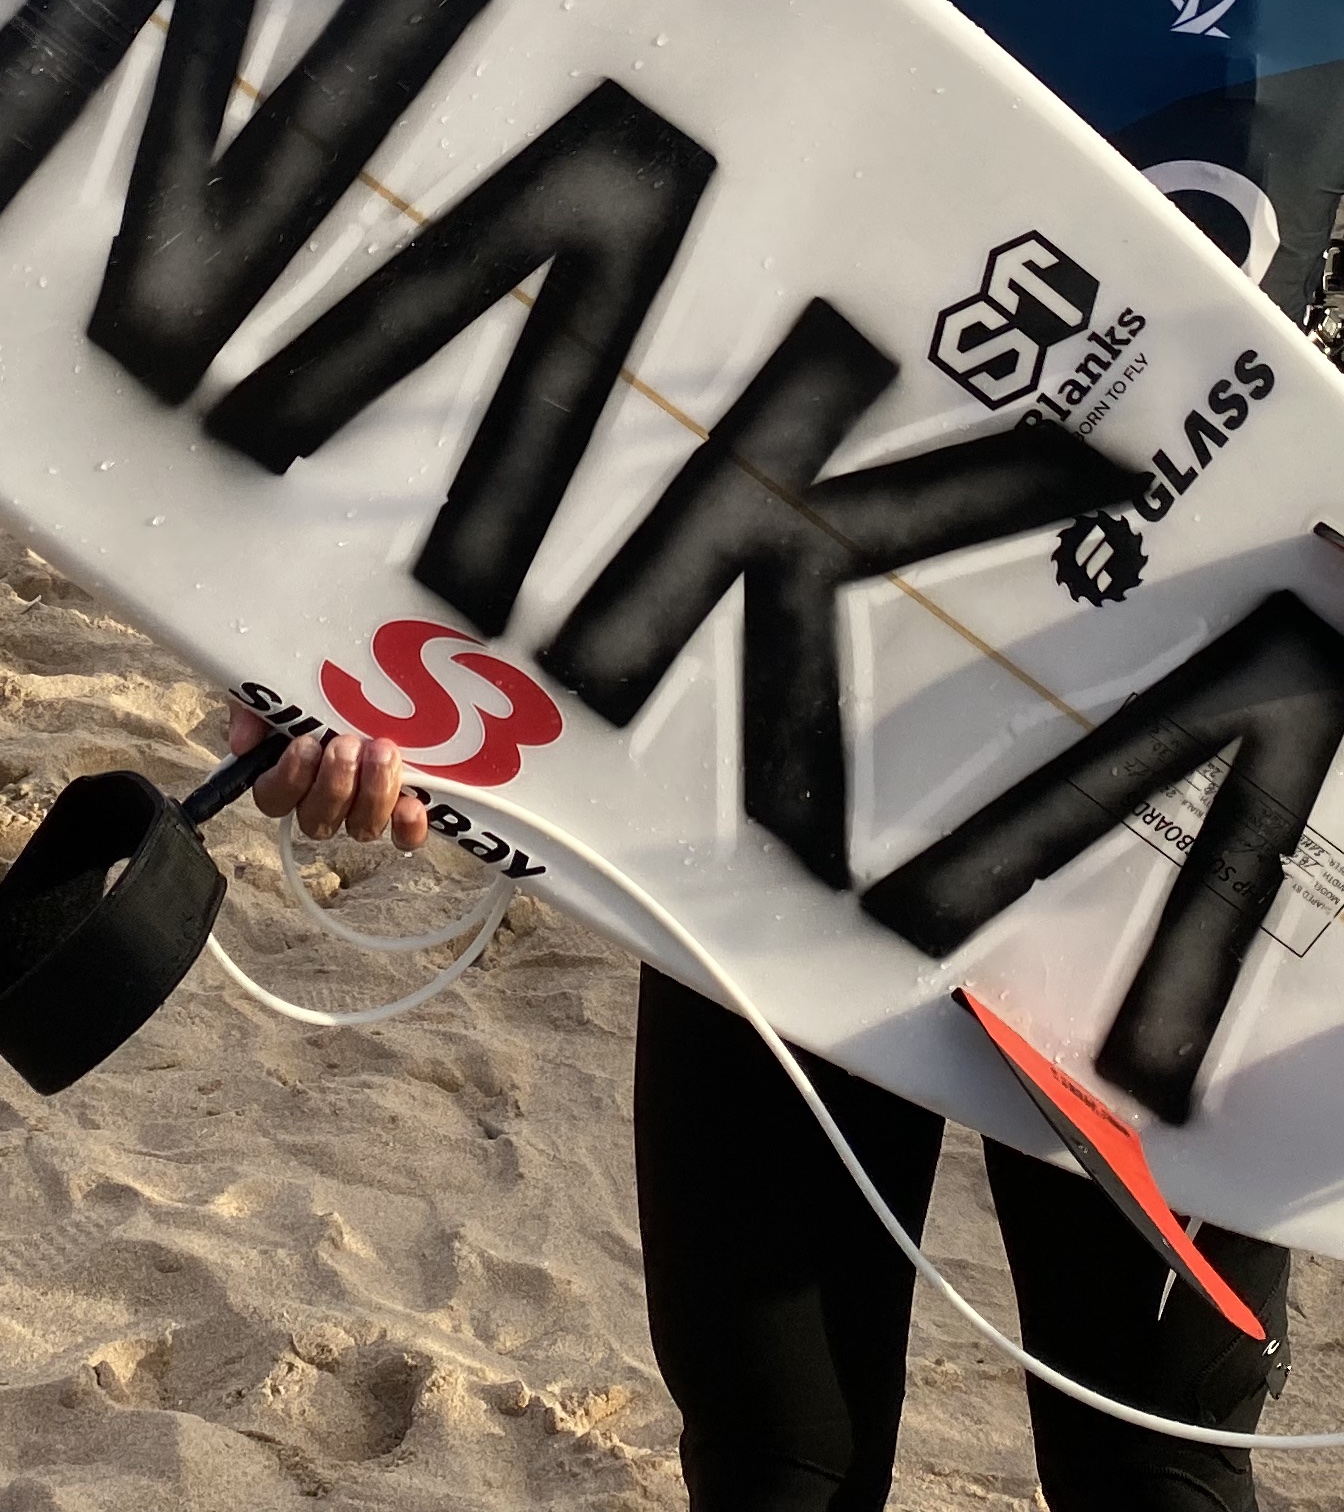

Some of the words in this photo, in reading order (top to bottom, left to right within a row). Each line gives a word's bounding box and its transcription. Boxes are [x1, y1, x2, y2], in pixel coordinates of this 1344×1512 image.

[937, 237, 1086, 402] ST
[1016, 307, 1147, 431] Blanks
[1104, 380, 1128, 401] TO
[1123, 352, 1149, 383] FLY
[1131, 349, 1276, 523] GLASS
